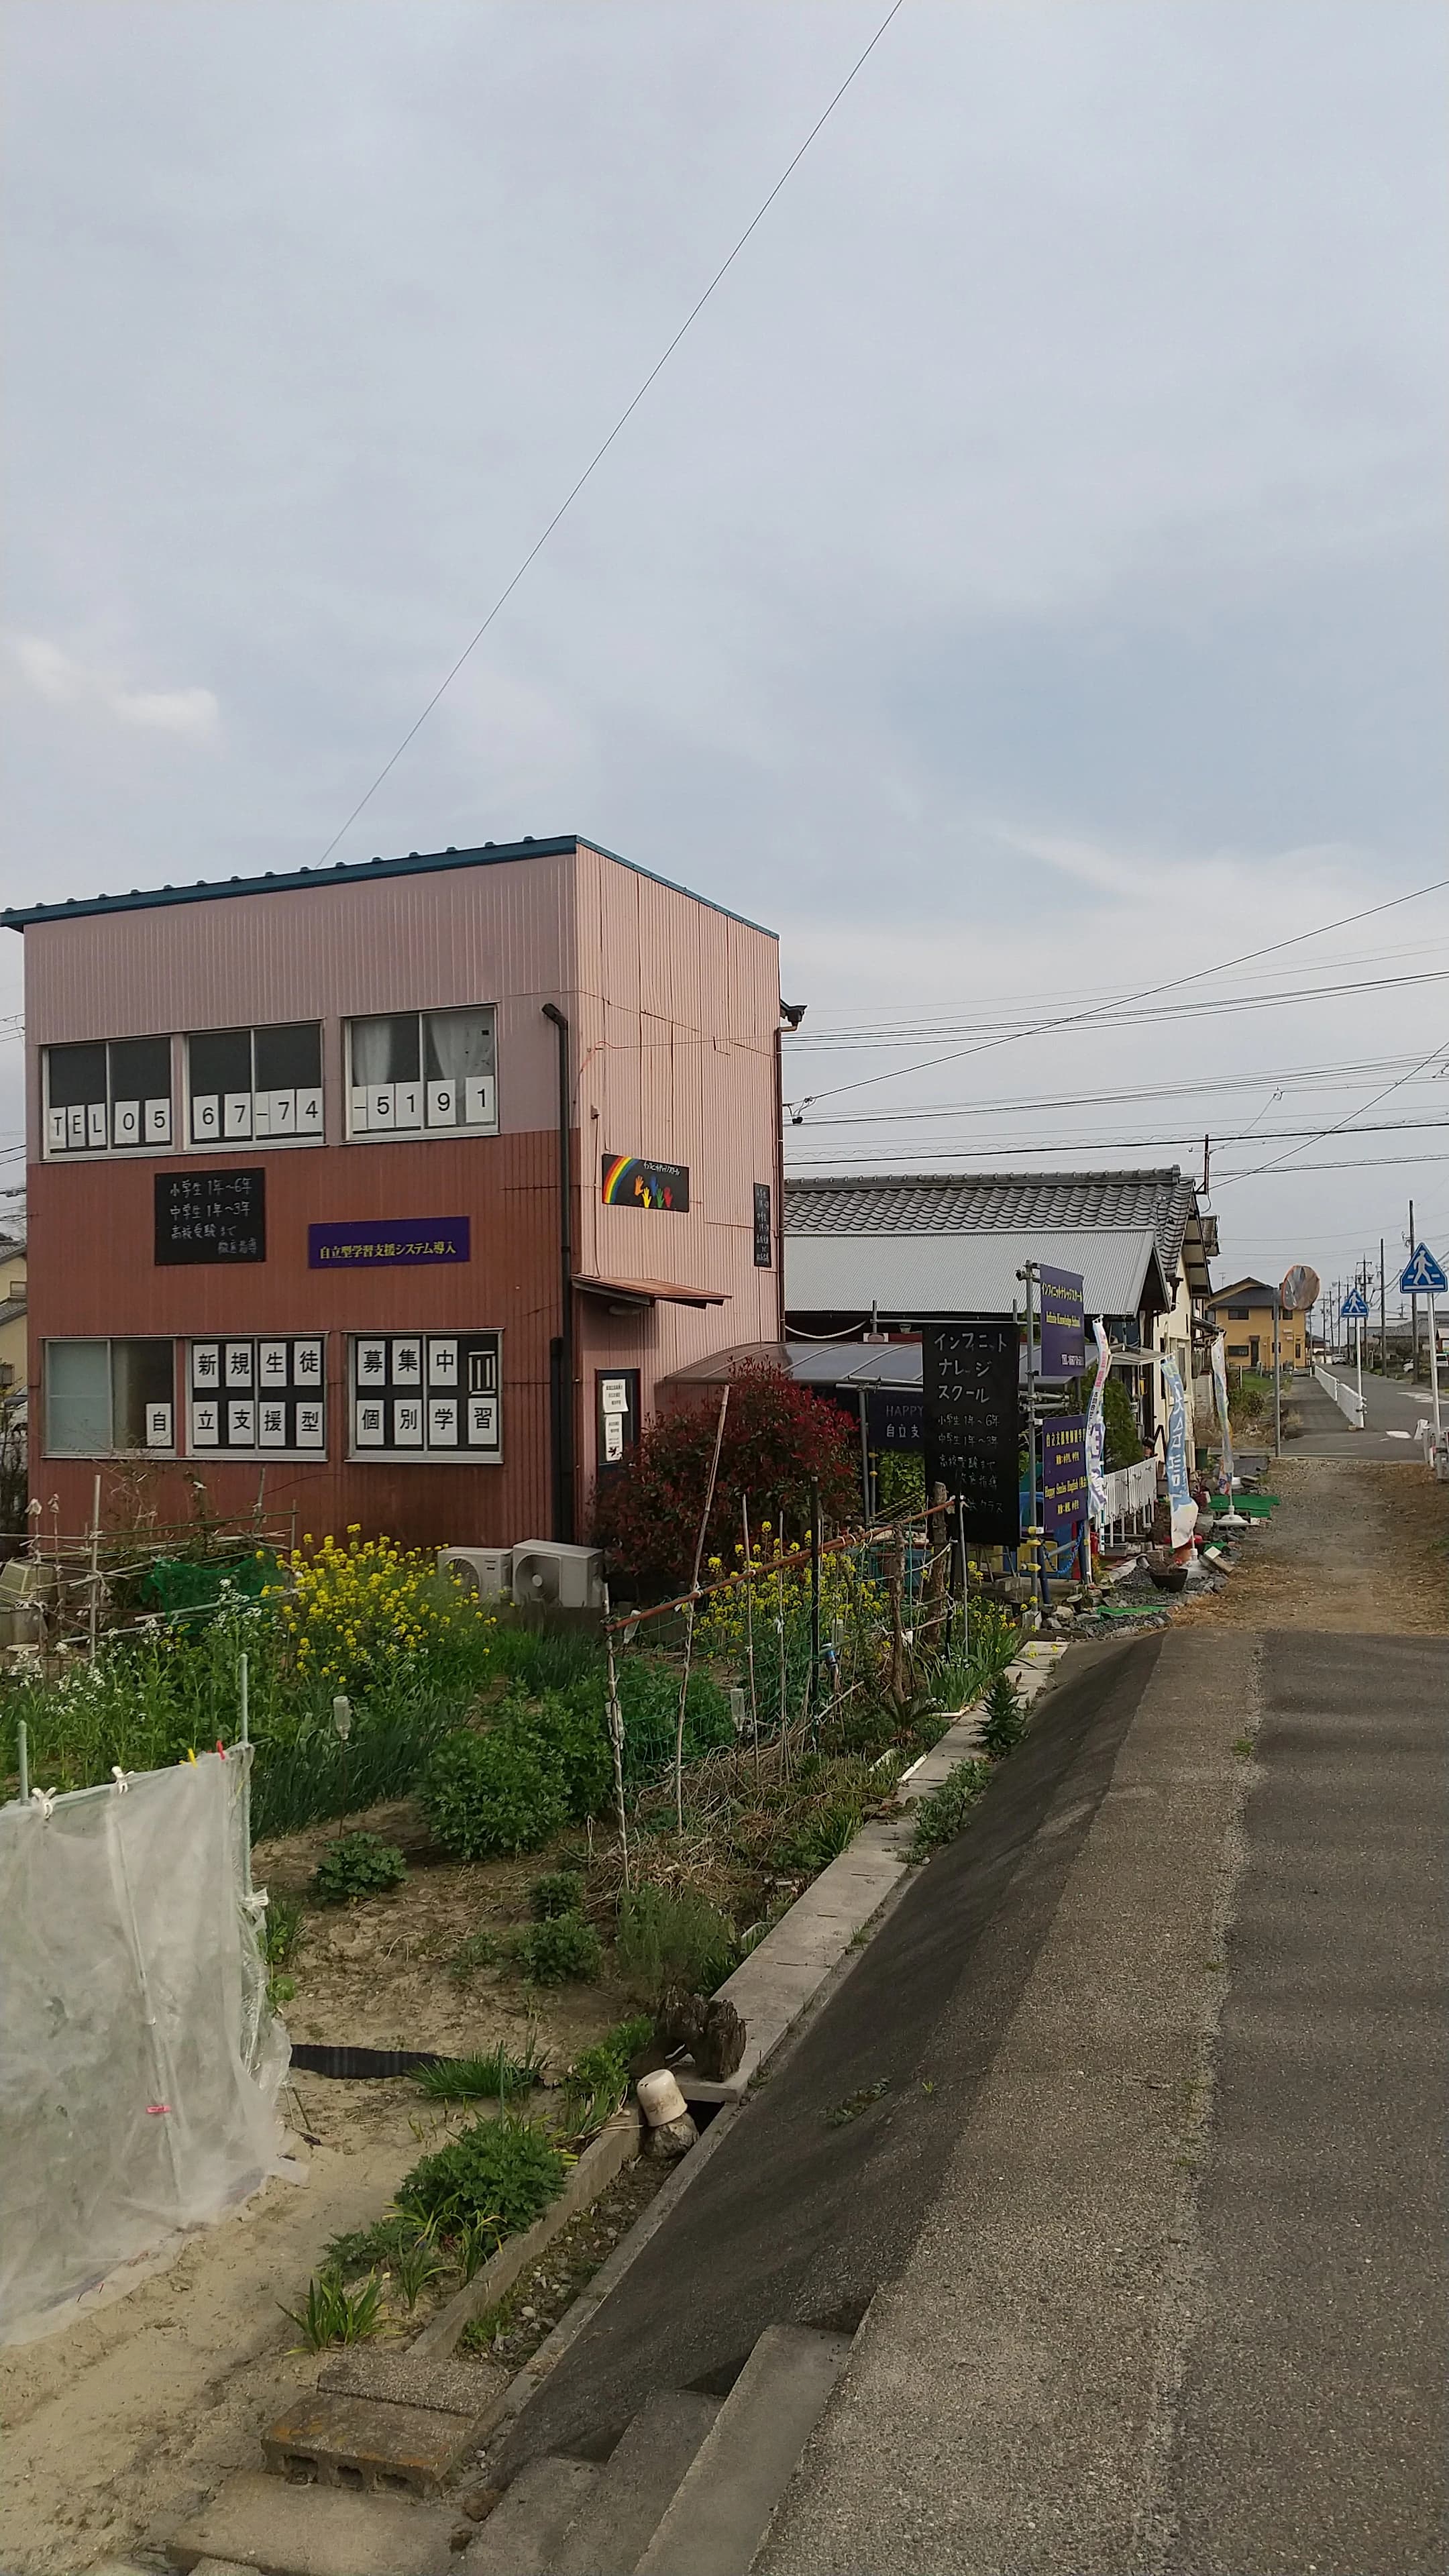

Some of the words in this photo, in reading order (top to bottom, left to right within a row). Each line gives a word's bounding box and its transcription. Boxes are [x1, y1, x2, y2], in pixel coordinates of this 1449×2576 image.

[53, 1114, 102, 1136] TEL
[320, 1241, 457, 1259] 自立型学習支援システム導入
[938, 1385, 990, 1403] スクール
[886, 1405, 924, 1417] HAPPY
